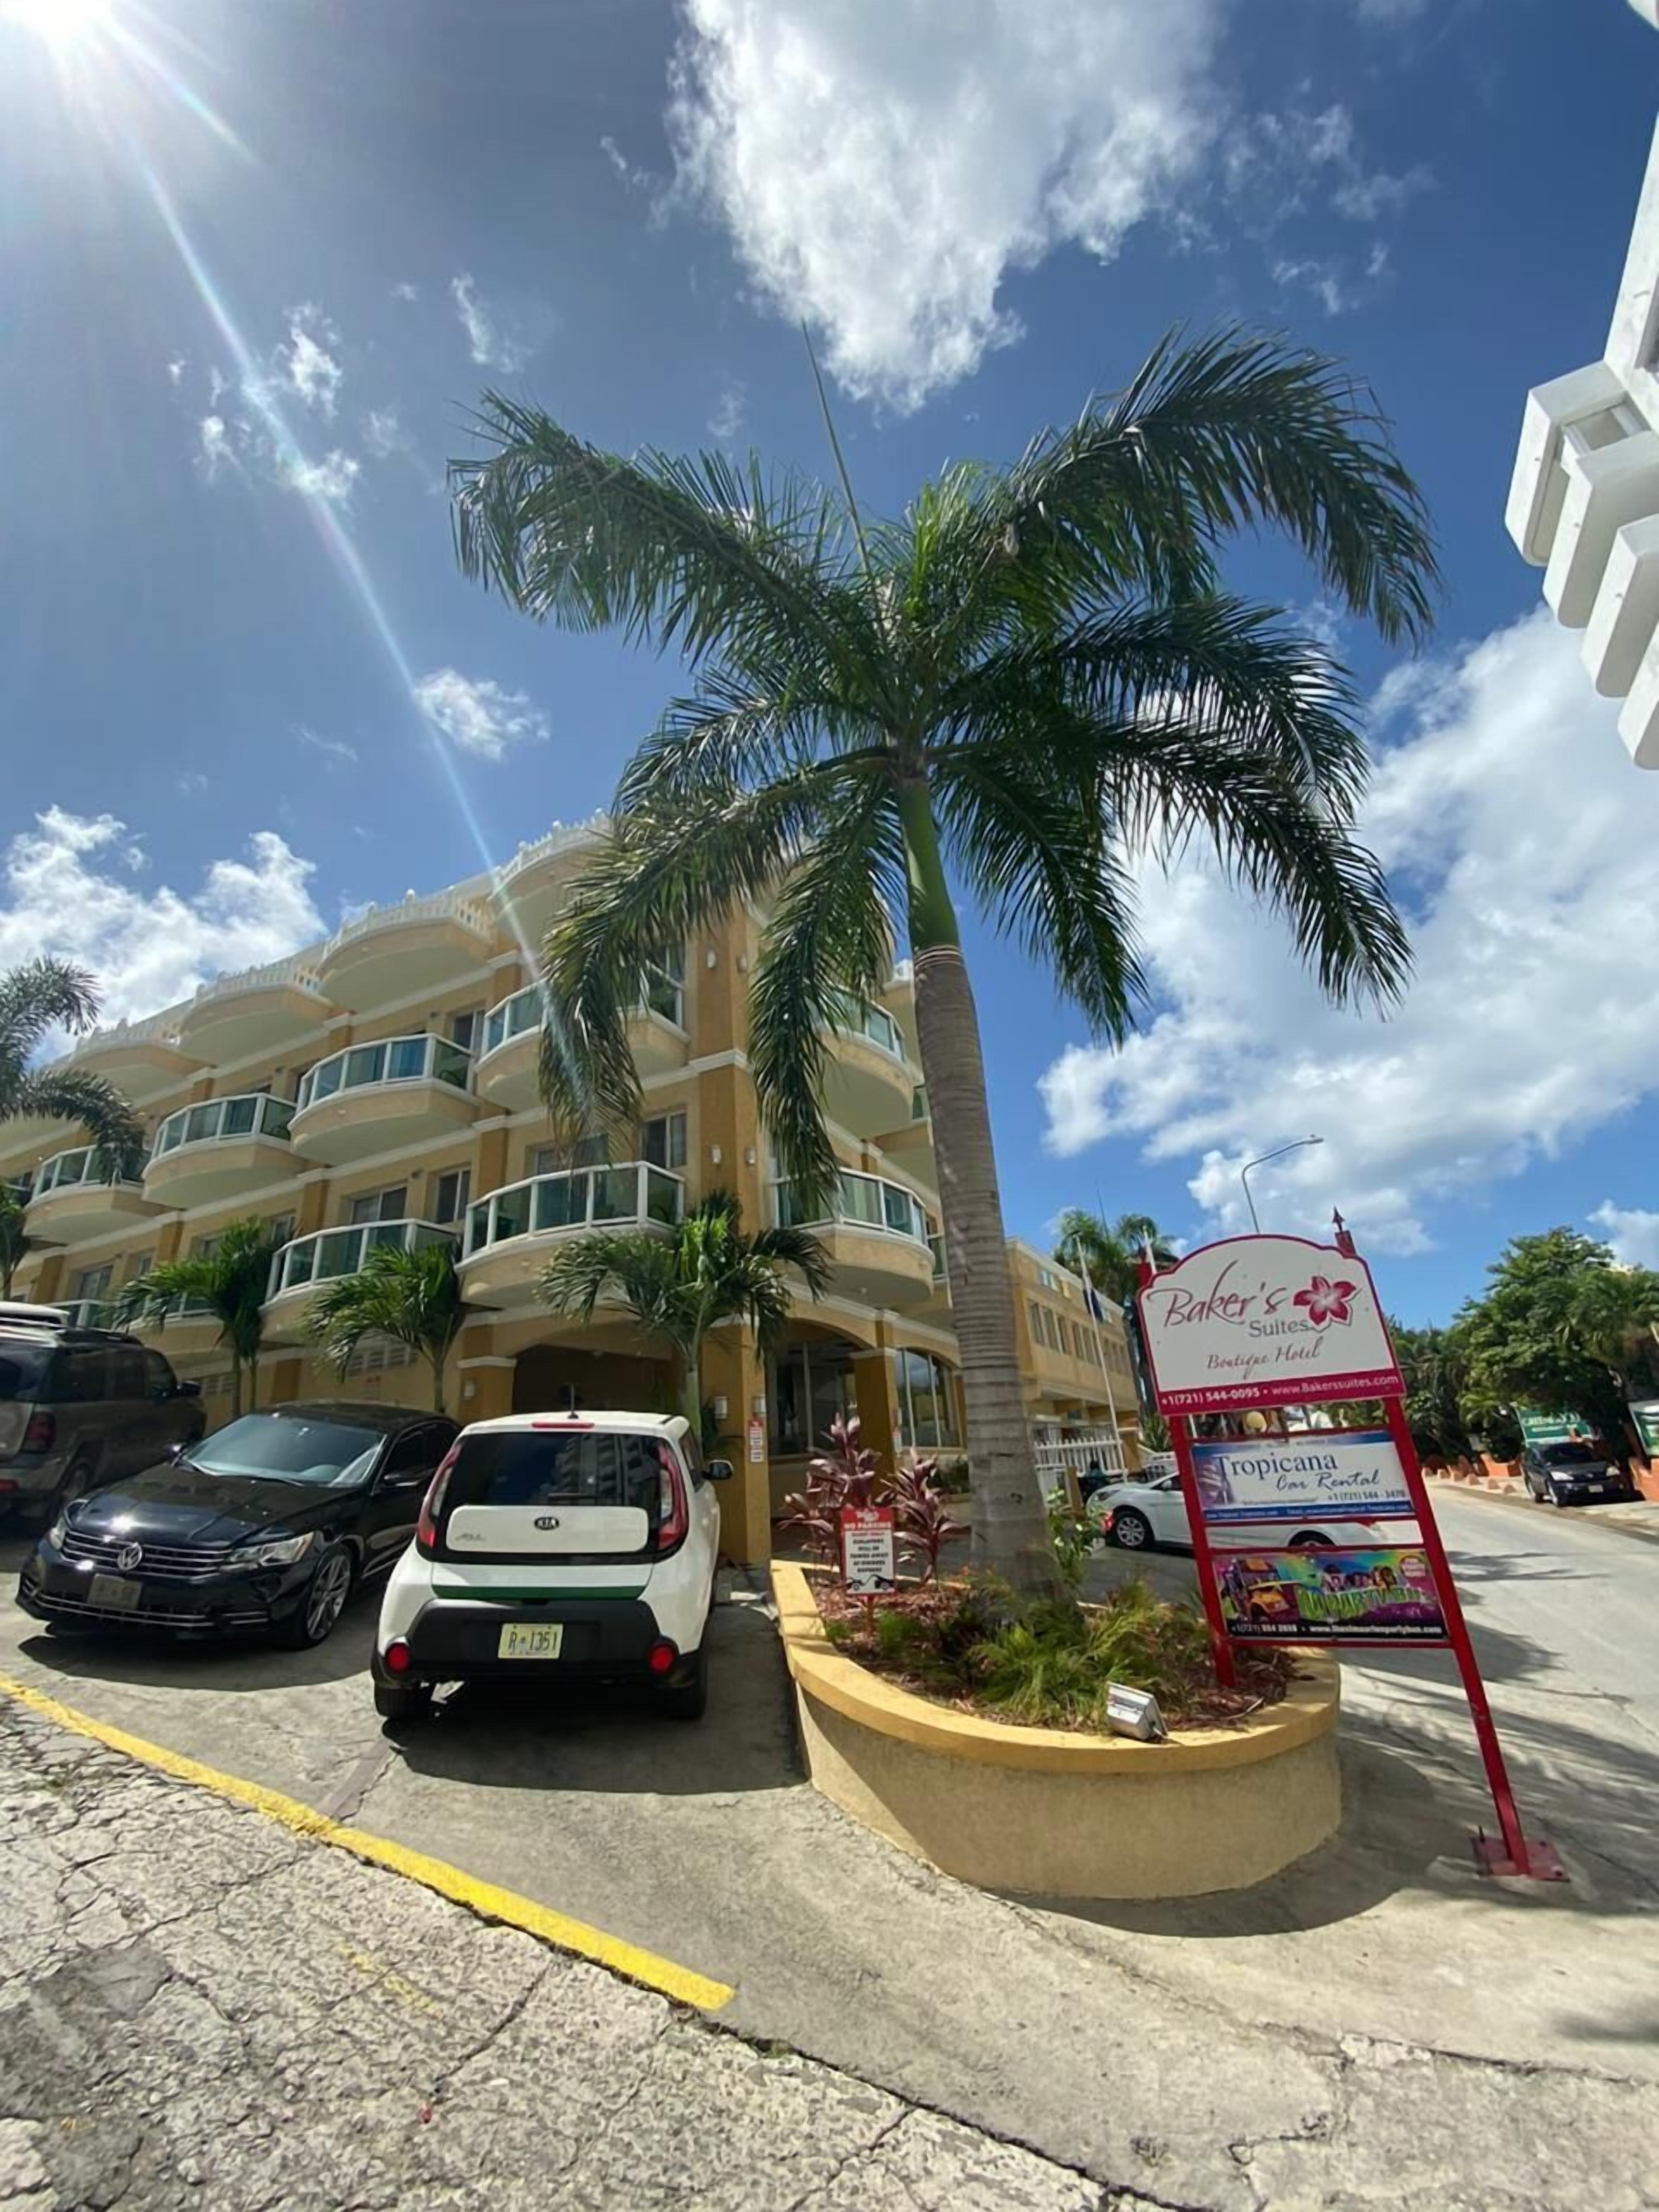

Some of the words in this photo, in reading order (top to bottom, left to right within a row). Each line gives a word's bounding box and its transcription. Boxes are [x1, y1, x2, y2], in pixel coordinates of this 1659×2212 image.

[1146, 1259, 1289, 1328] Baker's
[1248, 1319, 1311, 1338] Suites
[1207, 1353, 1269, 1380] Boutique
[1275, 1335, 1324, 1363] Hotel
[1216, 1452, 1339, 1481] Tropicana
[1277, 1474, 1308, 1491] Car
[1316, 1469, 1380, 1491] Rental
